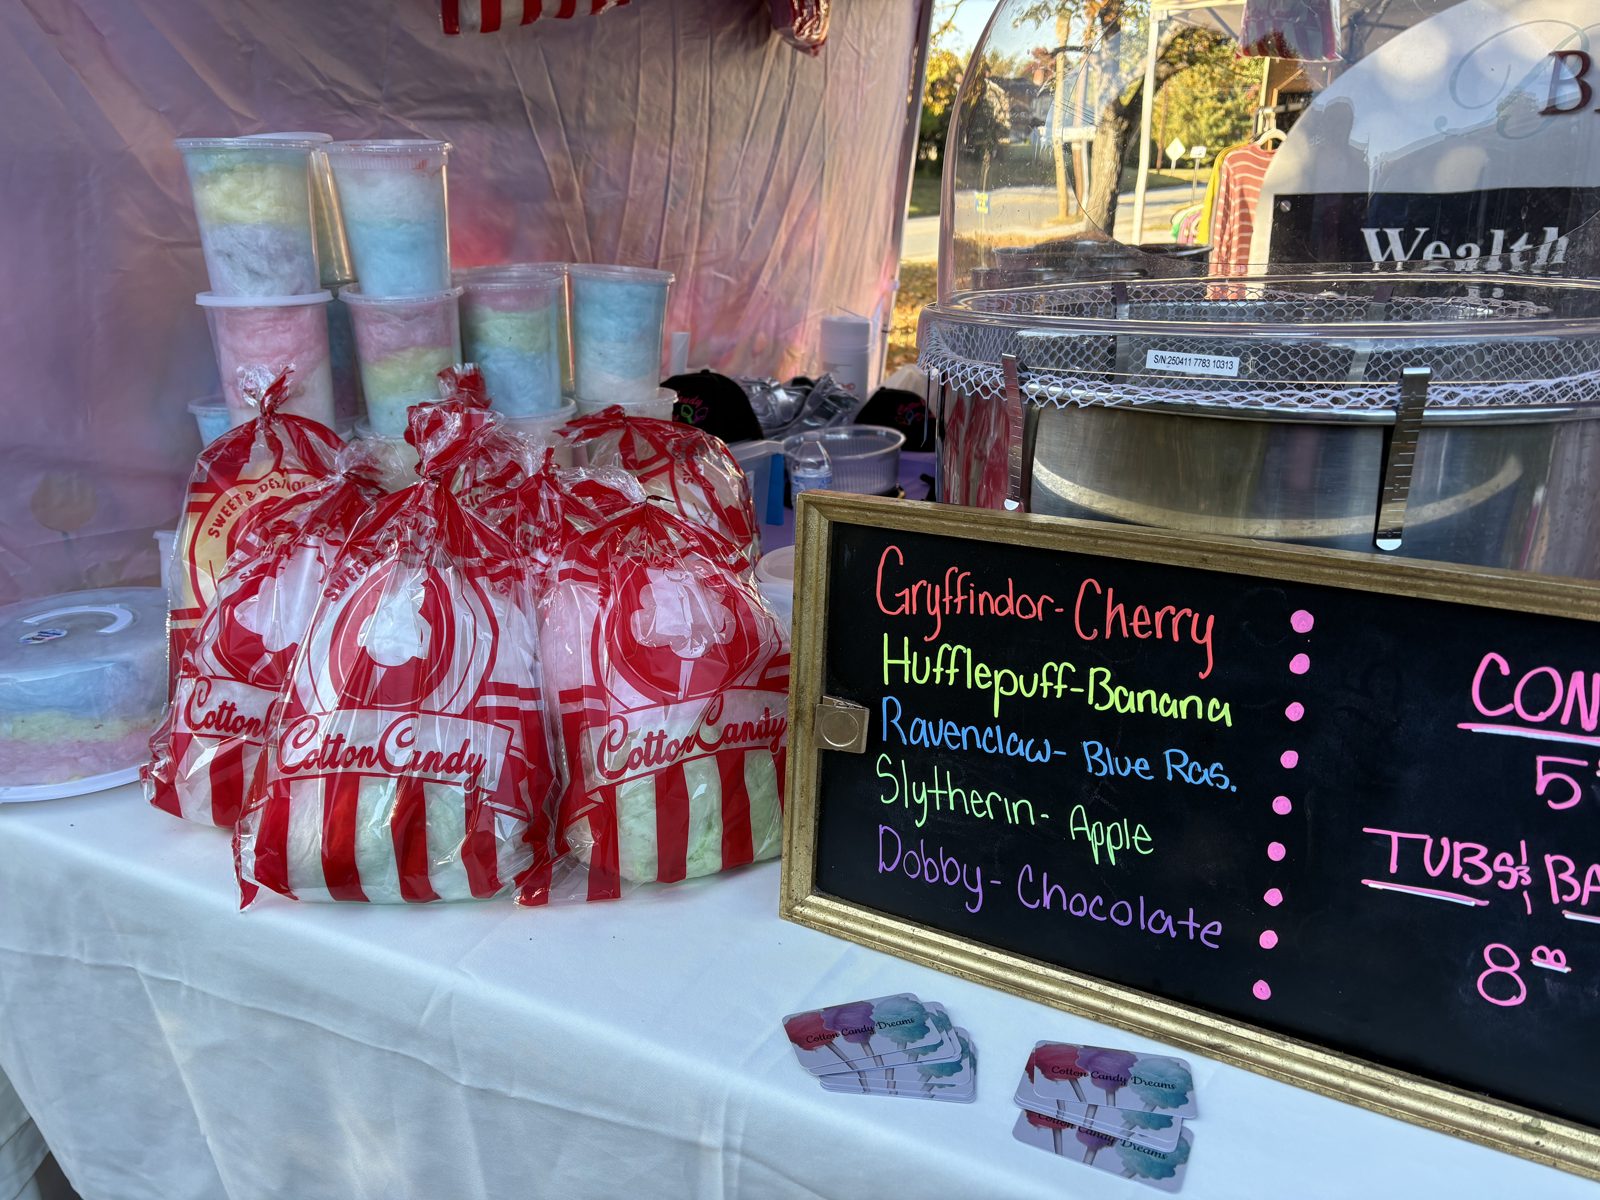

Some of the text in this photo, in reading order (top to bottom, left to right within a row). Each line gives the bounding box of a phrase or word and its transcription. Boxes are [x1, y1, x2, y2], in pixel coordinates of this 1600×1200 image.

[1540, 50, 1600, 115] B
[1361, 227, 1569, 271] Wealth
[1193, 357, 1211, 368] 7783
[1213, 360, 1234, 370] 10313
[207, 493, 244, 539] SWEET
[245, 491, 257, 502] &
[1073, 577, 1215, 680] Cherry
[183, 676, 261, 738] Cotton
[277, 714, 377, 775] Cotton
[597, 692, 787, 780] Cotton Candy
[1082, 740, 1155, 781] Blue
[1163, 747, 1237, 793] Ras.
[1069, 804, 1154, 866] Apple
[1017, 863, 1223, 950] Chocolate
[805, 1017, 915, 1044] Cotton Candy Dreams
[1051, 1065, 1176, 1090] Cotton Candy Dreams
[1120, 1138, 1168, 1160] Dreams
